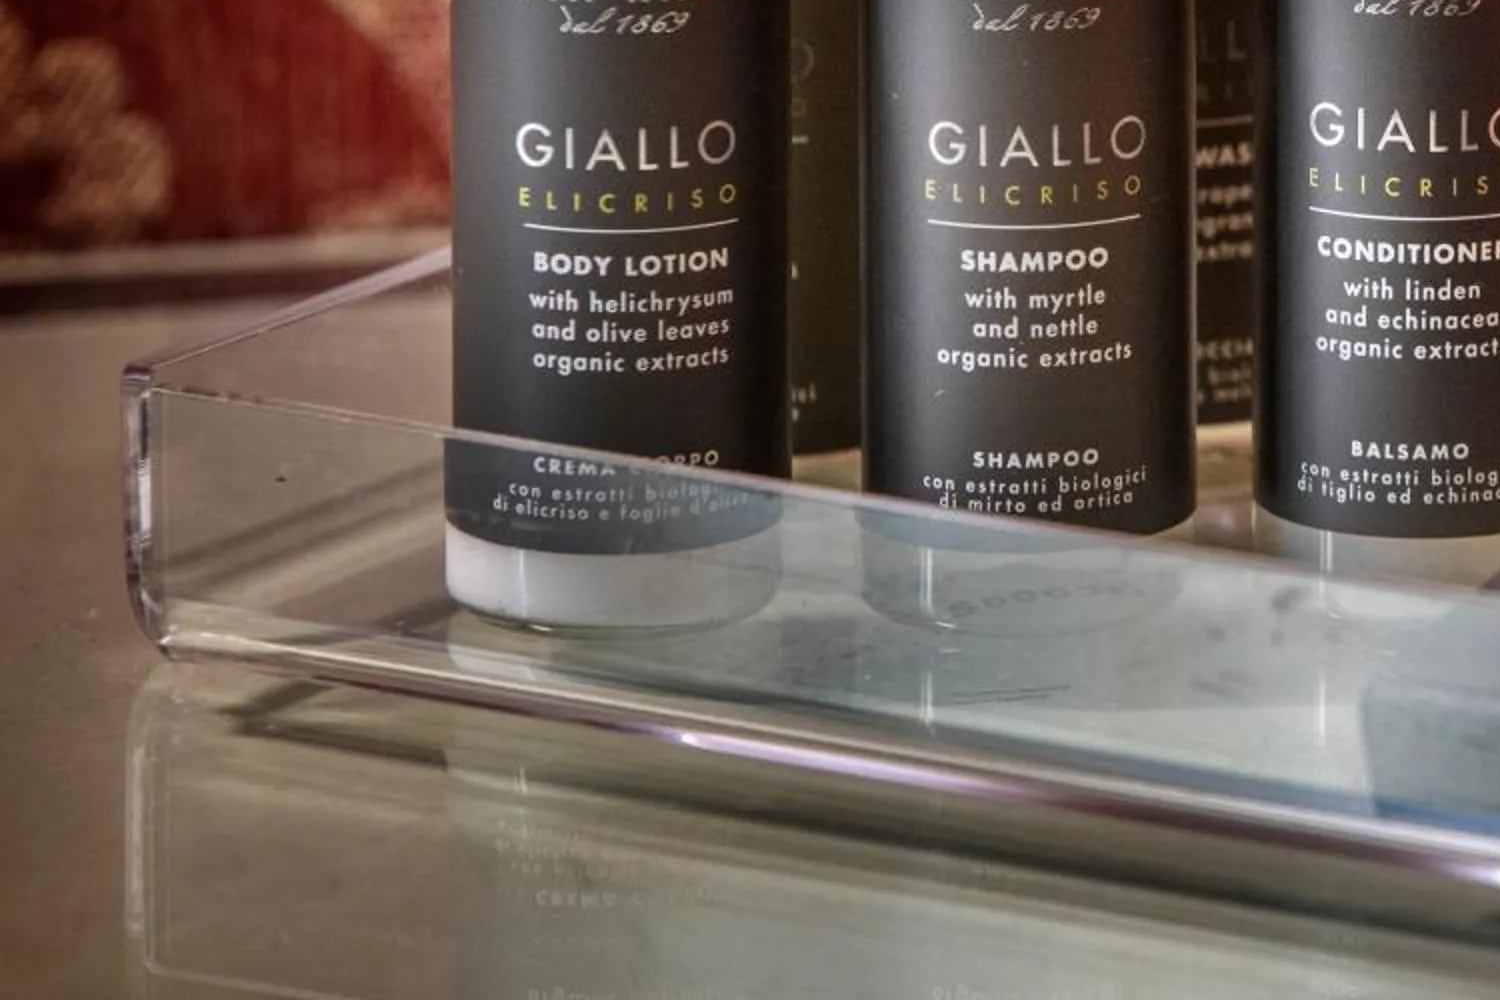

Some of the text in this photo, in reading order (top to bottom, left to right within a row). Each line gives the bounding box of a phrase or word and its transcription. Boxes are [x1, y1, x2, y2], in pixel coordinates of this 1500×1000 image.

[516, 120, 736, 171] GIALLO
[928, 115, 1146, 167] GIALLO
[518, 183, 737, 213] ELICRISO
[925, 175, 1141, 205] ELICRISO
[533, 248, 729, 277] BODY LOTION
[961, 247, 1109, 273] SHAMPOO
[529, 288, 734, 316] with helichrysum
[965, 284, 1106, 314] with myrtle
[1344, 278, 1481, 301] with linden
[973, 314, 1099, 339] and nettle
[1325, 306, 1499, 330] and echinacea
[532, 319, 730, 343] and olive leaves
[937, 342, 1133, 372] organic extracts
[1316, 336, 1403, 360] organic
[532, 347, 729, 375] organic extracts
[973, 449, 1099, 470] SHAMPOO
[1351, 440, 1469, 461] BALSAMO
[533, 456, 616, 476] CREMA
[1301, 461, 1330, 478] con
[1340, 467, 1420, 485] estratti
[509, 483, 541, 499] con
[923, 465, 1147, 494] con estratti biologici
[1297, 477, 1313, 494] di
[1321, 485, 1376, 503] tiglio
[1387, 487, 1412, 504] ed
[493, 495, 508, 512] di
[515, 499, 590, 520] elicriso
[599, 508, 609, 520] e
[939, 491, 1133, 513] di mirto ed ortica
